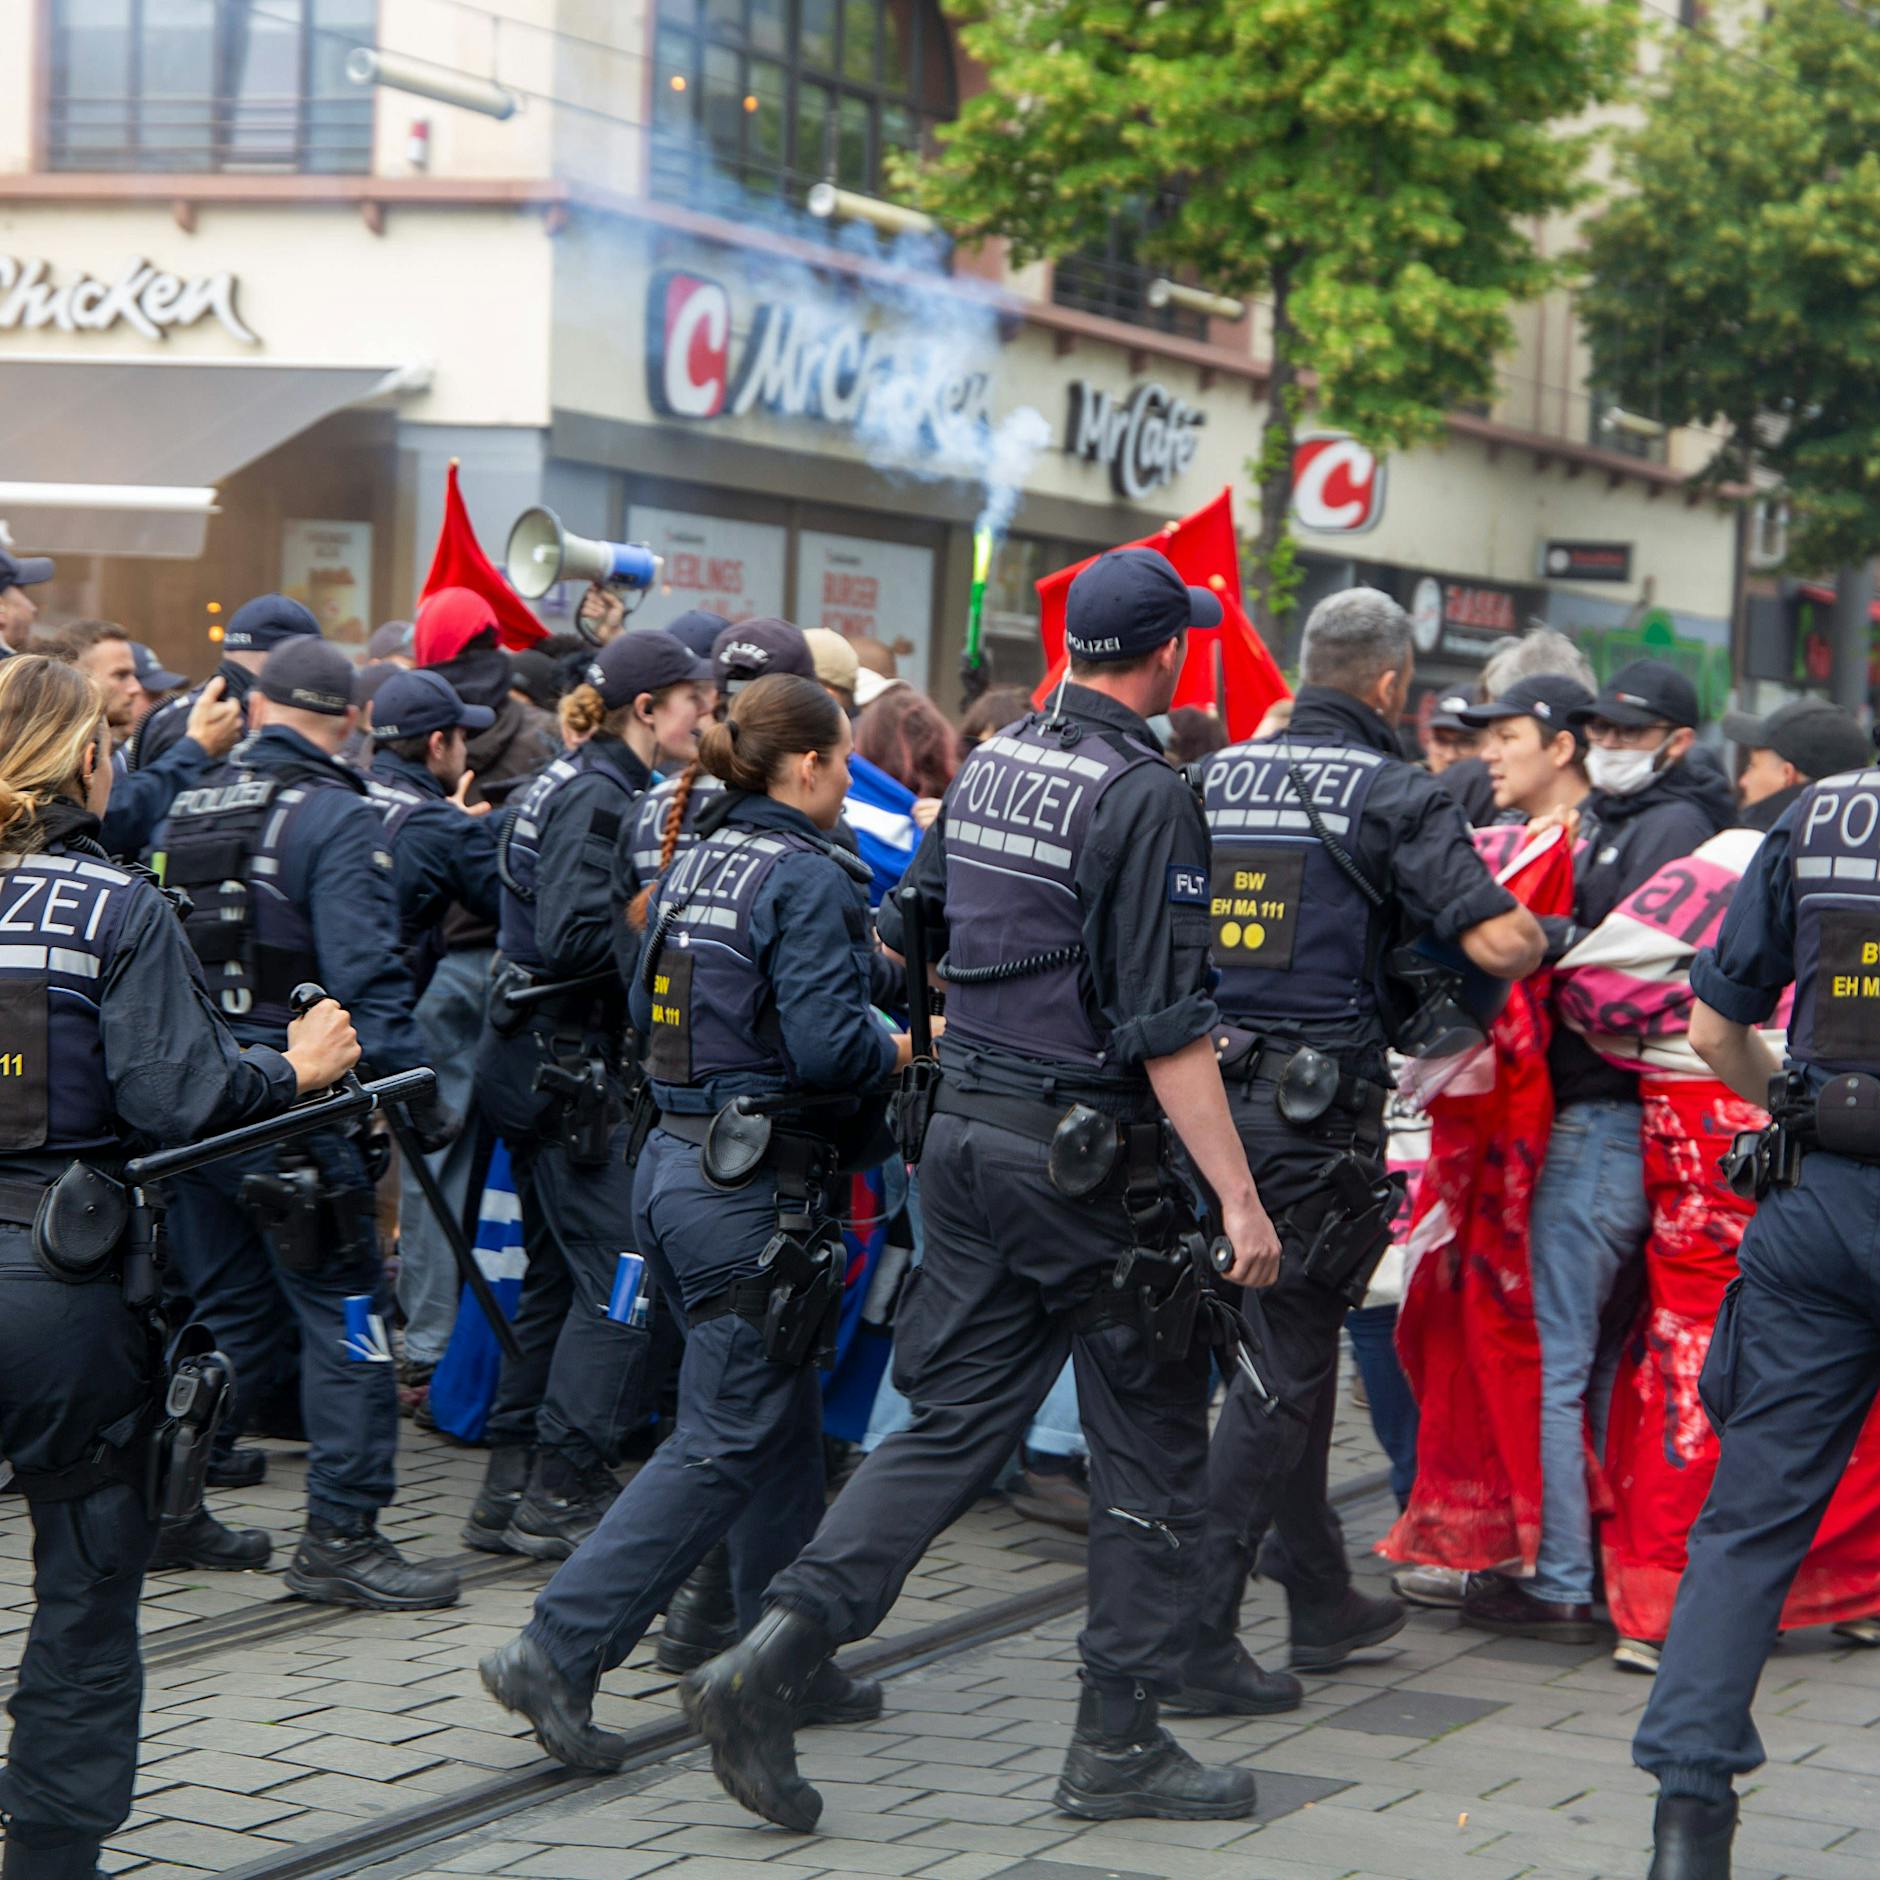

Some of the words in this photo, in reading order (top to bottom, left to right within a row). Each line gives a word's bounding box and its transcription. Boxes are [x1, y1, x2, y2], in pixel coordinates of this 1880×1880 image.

[1204, 761, 1363, 808] POLIZEI
[168, 780, 274, 817] POLIZEI
[952, 760, 1083, 837] POLIZEI
[1176, 873, 1205, 895] FLT
[1233, 871, 1267, 891] BW
[0, 875, 111, 941] ZEI
[1210, 898, 1233, 916] EH
[1234, 898, 1258, 917] MA
[1261, 901, 1286, 920] 111
[1861, 942, 1880, 965] B
[1832, 976, 1858, 997] EH
[665, 1007, 680, 1026] 111
